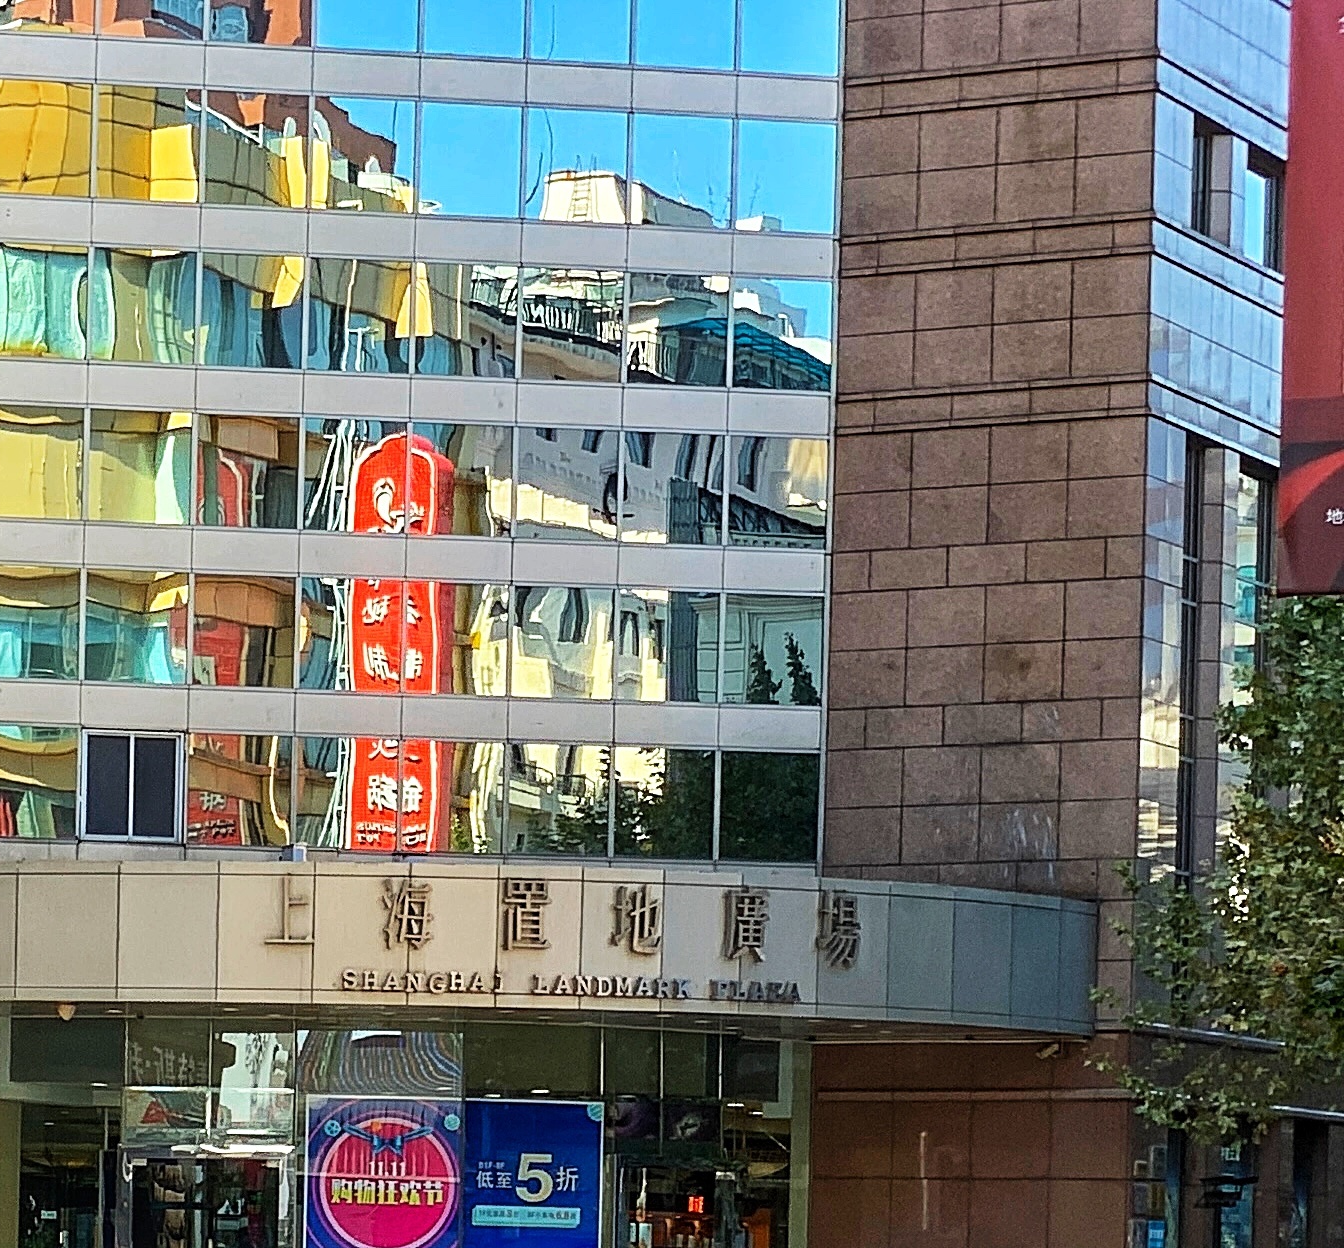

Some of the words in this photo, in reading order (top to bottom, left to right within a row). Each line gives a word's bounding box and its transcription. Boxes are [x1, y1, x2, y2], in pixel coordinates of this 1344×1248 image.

[264, 873, 862, 969] 上海置地廣場
[342, 968, 504, 994] SHANGHAI
[532, 974, 692, 999] LANDMARK
[709, 978, 802, 1002] PLAZA
[369, 1160, 407, 1178] 11.11
[476, 1152, 579, 1203] 低至5折
[331, 1178, 443, 1206] 购物狂欢节
